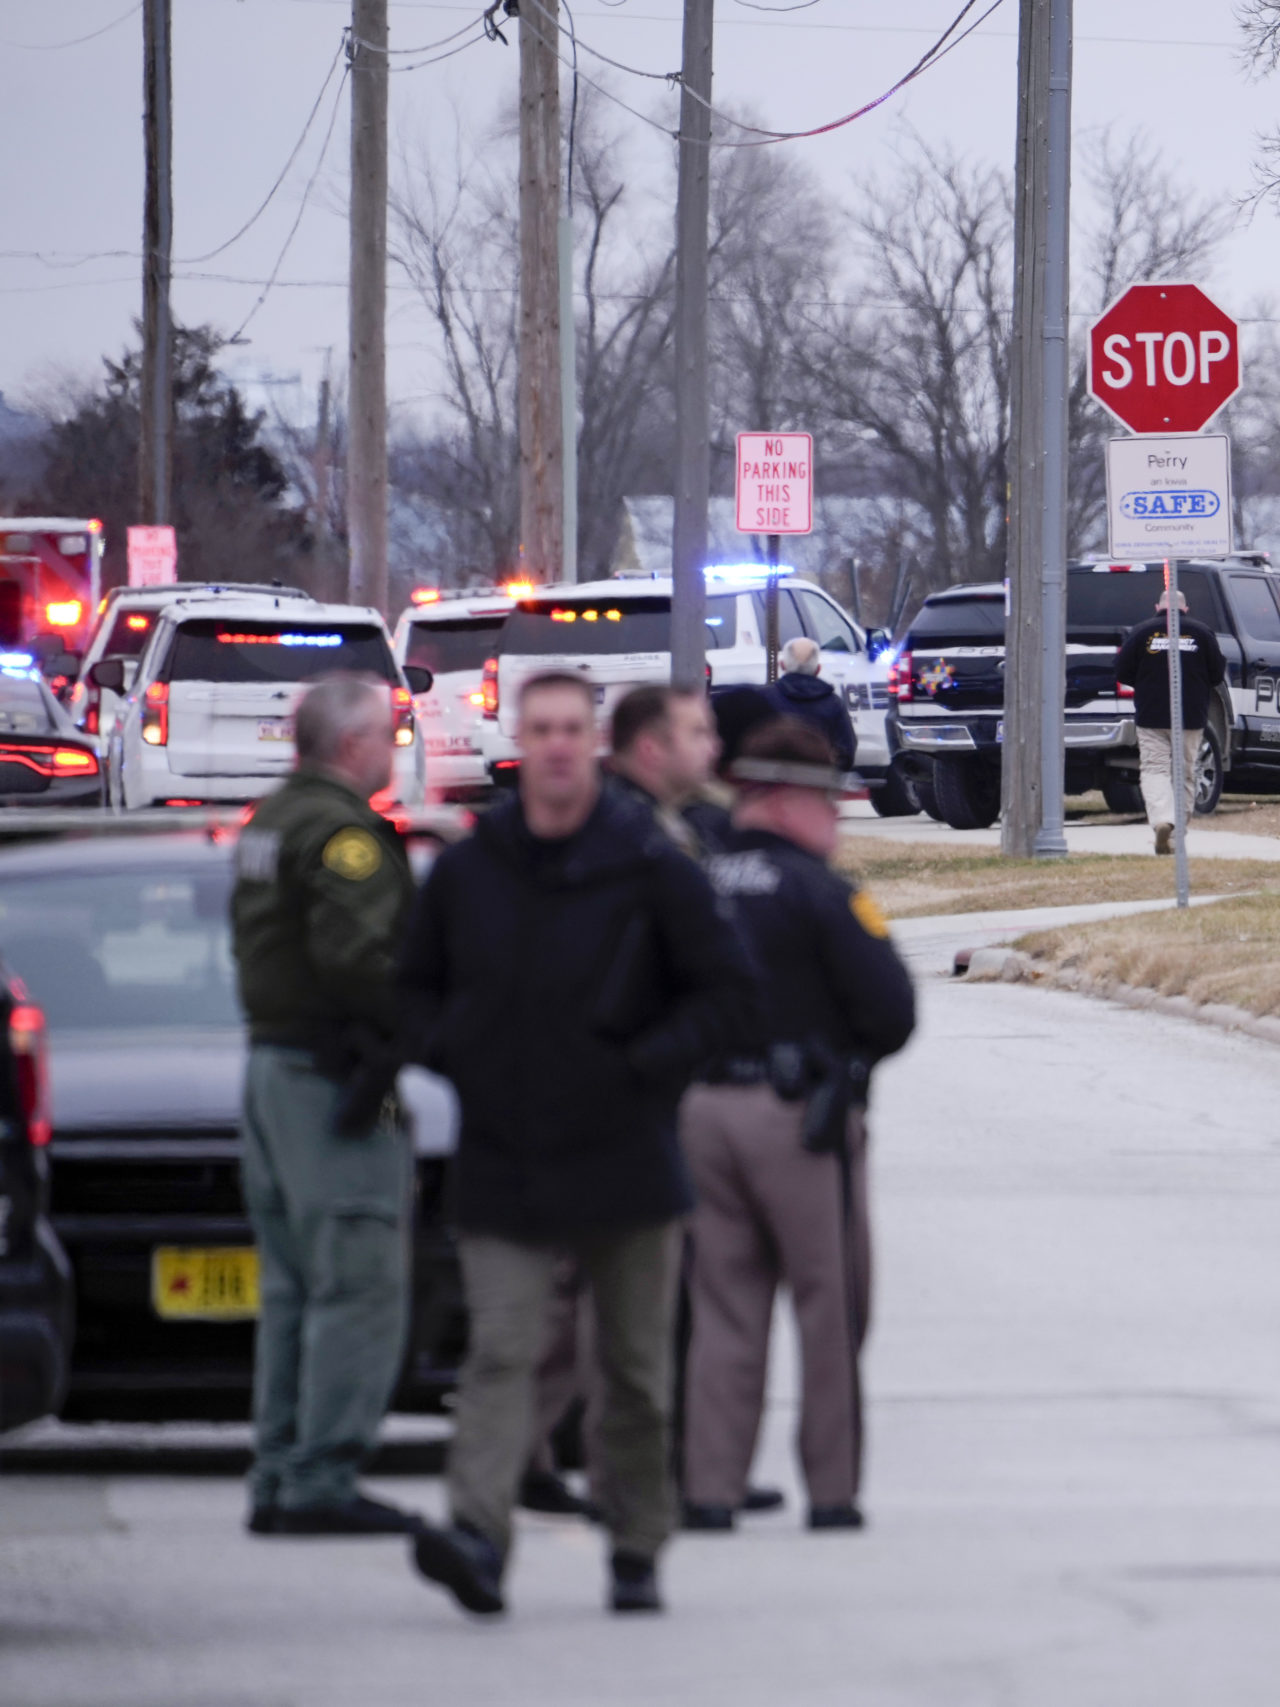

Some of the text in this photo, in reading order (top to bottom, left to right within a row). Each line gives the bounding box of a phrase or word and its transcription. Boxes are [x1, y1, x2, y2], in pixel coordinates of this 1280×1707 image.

[1102, 330, 1230, 389] STOP
[764, 439, 783, 456] NO
[743, 461, 806, 479] PARKING
[1147, 454, 1188, 470] Perry
[757, 484, 791, 502] THIS
[1133, 494, 1206, 515] SAFE
[756, 507, 790, 526] SIDE
[1145, 523, 1194, 532] Community
